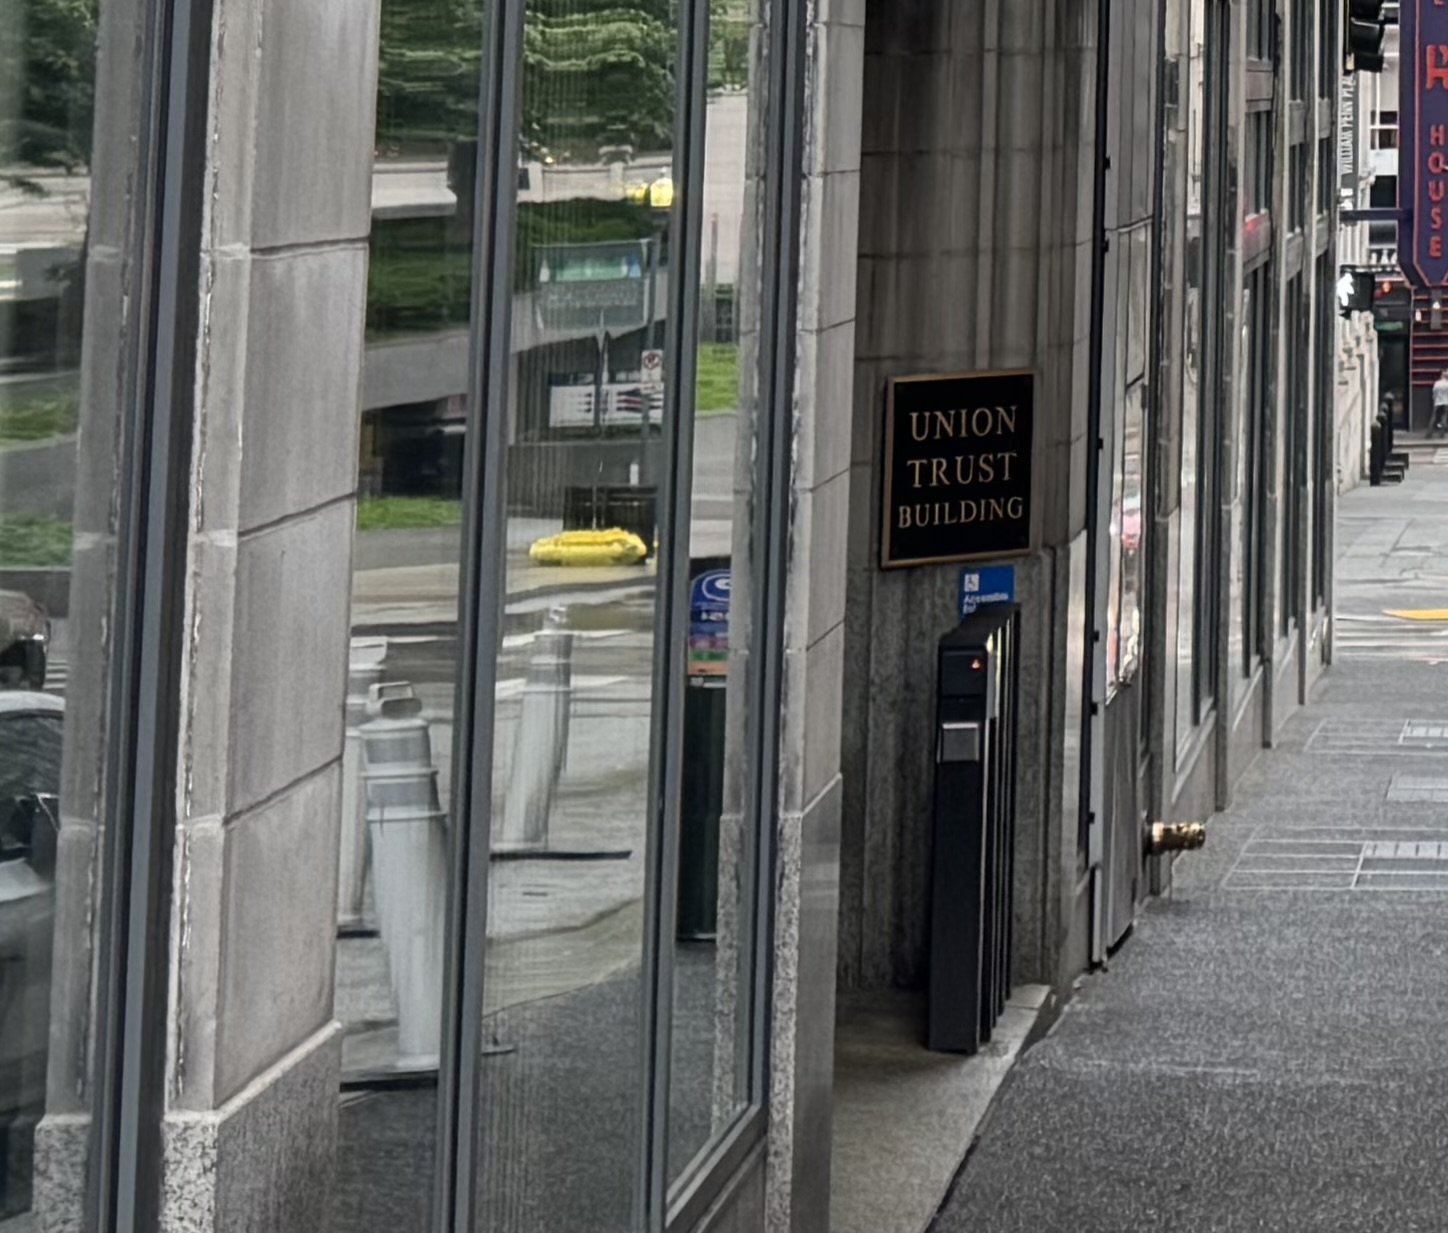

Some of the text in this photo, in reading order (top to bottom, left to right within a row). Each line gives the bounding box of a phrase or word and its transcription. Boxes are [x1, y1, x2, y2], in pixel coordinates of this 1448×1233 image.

[1428, 124, 1447, 258] HOUSE
[909, 406, 1017, 440] UNION
[907, 452, 1017, 487] TRUST
[898, 496, 1023, 528] BUILDING
